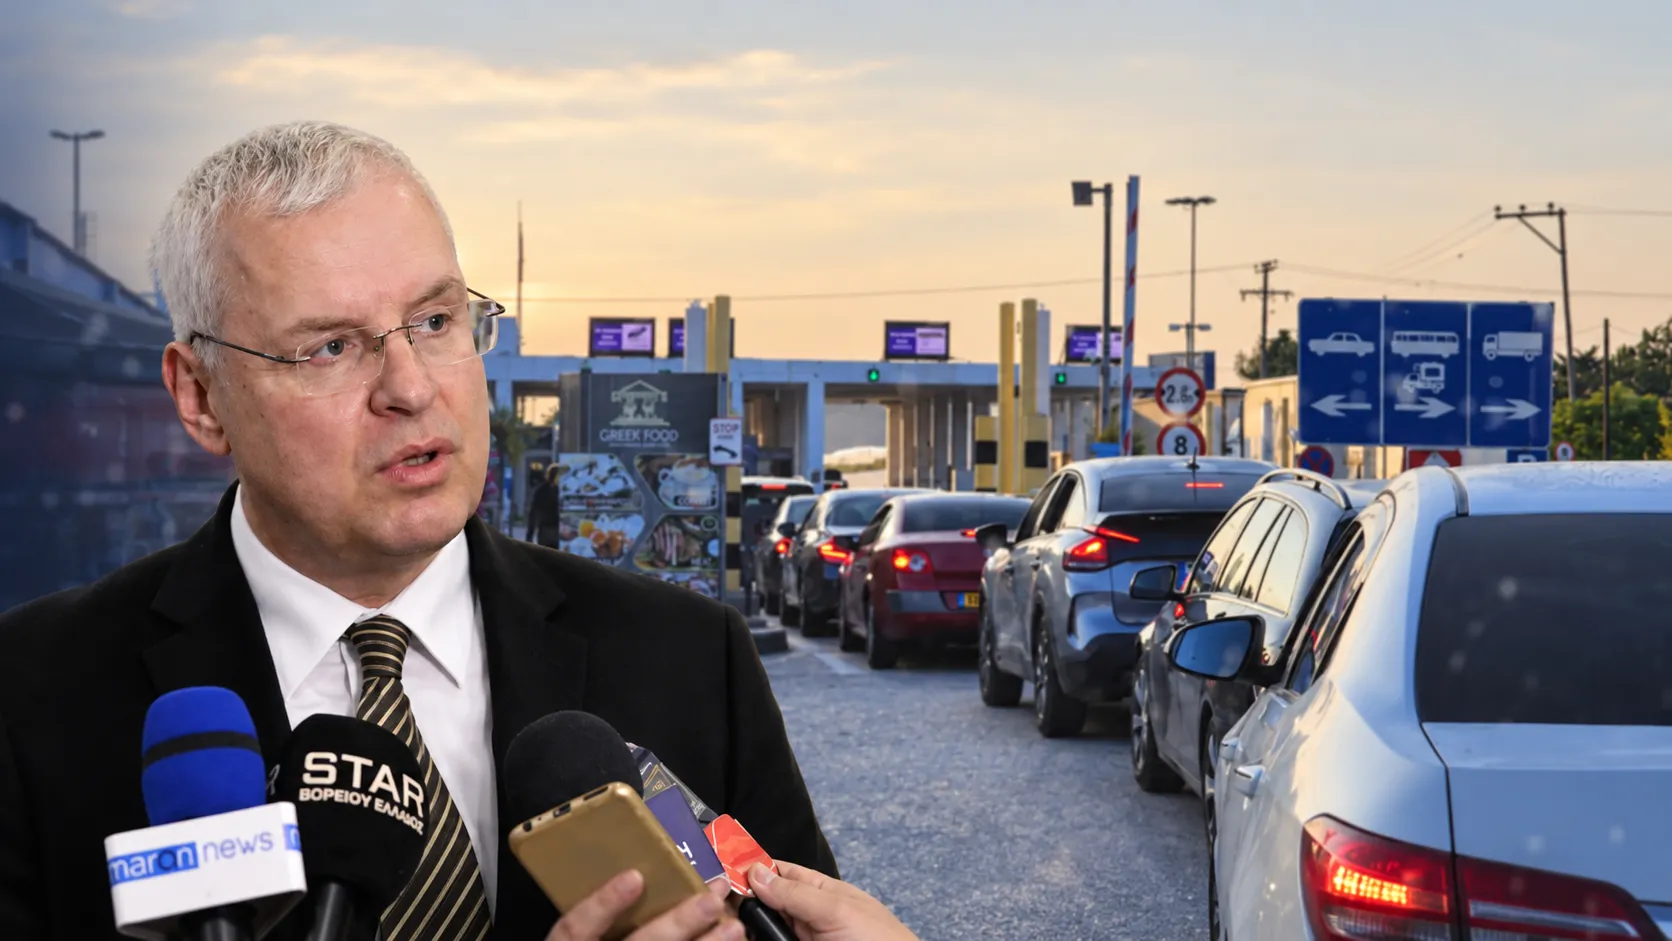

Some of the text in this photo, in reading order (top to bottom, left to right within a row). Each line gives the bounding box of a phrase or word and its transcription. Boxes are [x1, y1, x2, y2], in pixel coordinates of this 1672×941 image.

[600, 429, 679, 441] GREEK FOOD
[713, 423, 739, 433] STOP
[1174, 434, 1187, 455] 8
[302, 751, 424, 818] STAR
[299, 787, 372, 808] ΒΟΡΕΙΟΥ
[202, 831, 274, 863] news
